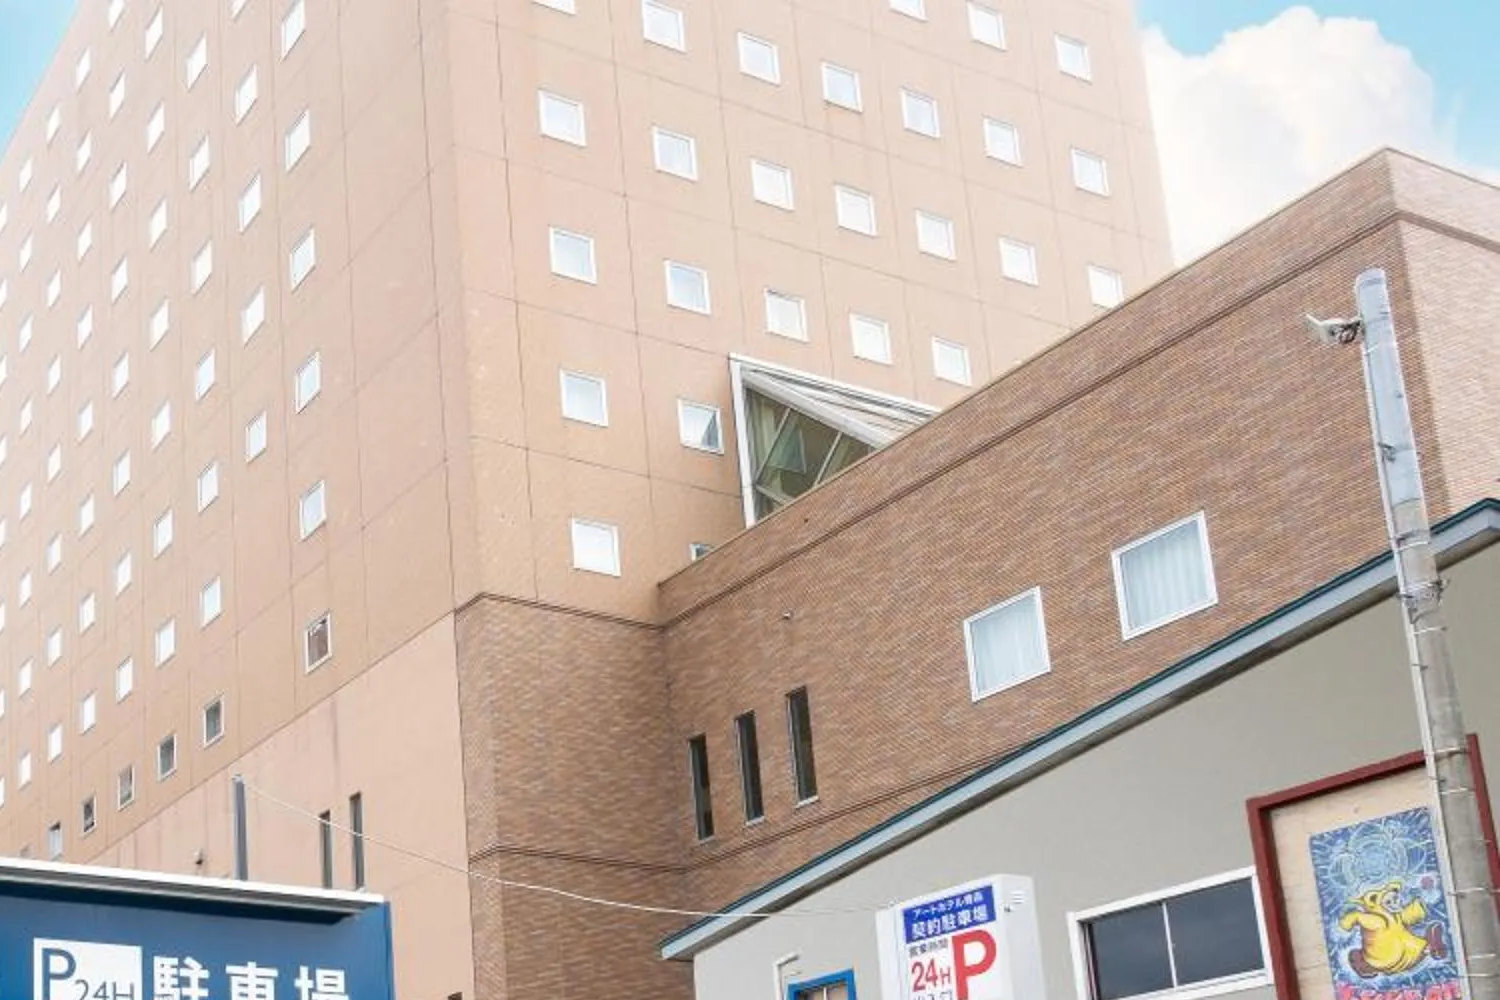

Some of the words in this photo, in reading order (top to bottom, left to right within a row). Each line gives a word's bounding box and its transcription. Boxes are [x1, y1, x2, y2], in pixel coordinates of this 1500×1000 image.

[911, 904, 990, 940] 契約駐車場
[911, 959, 952, 993] 24H
